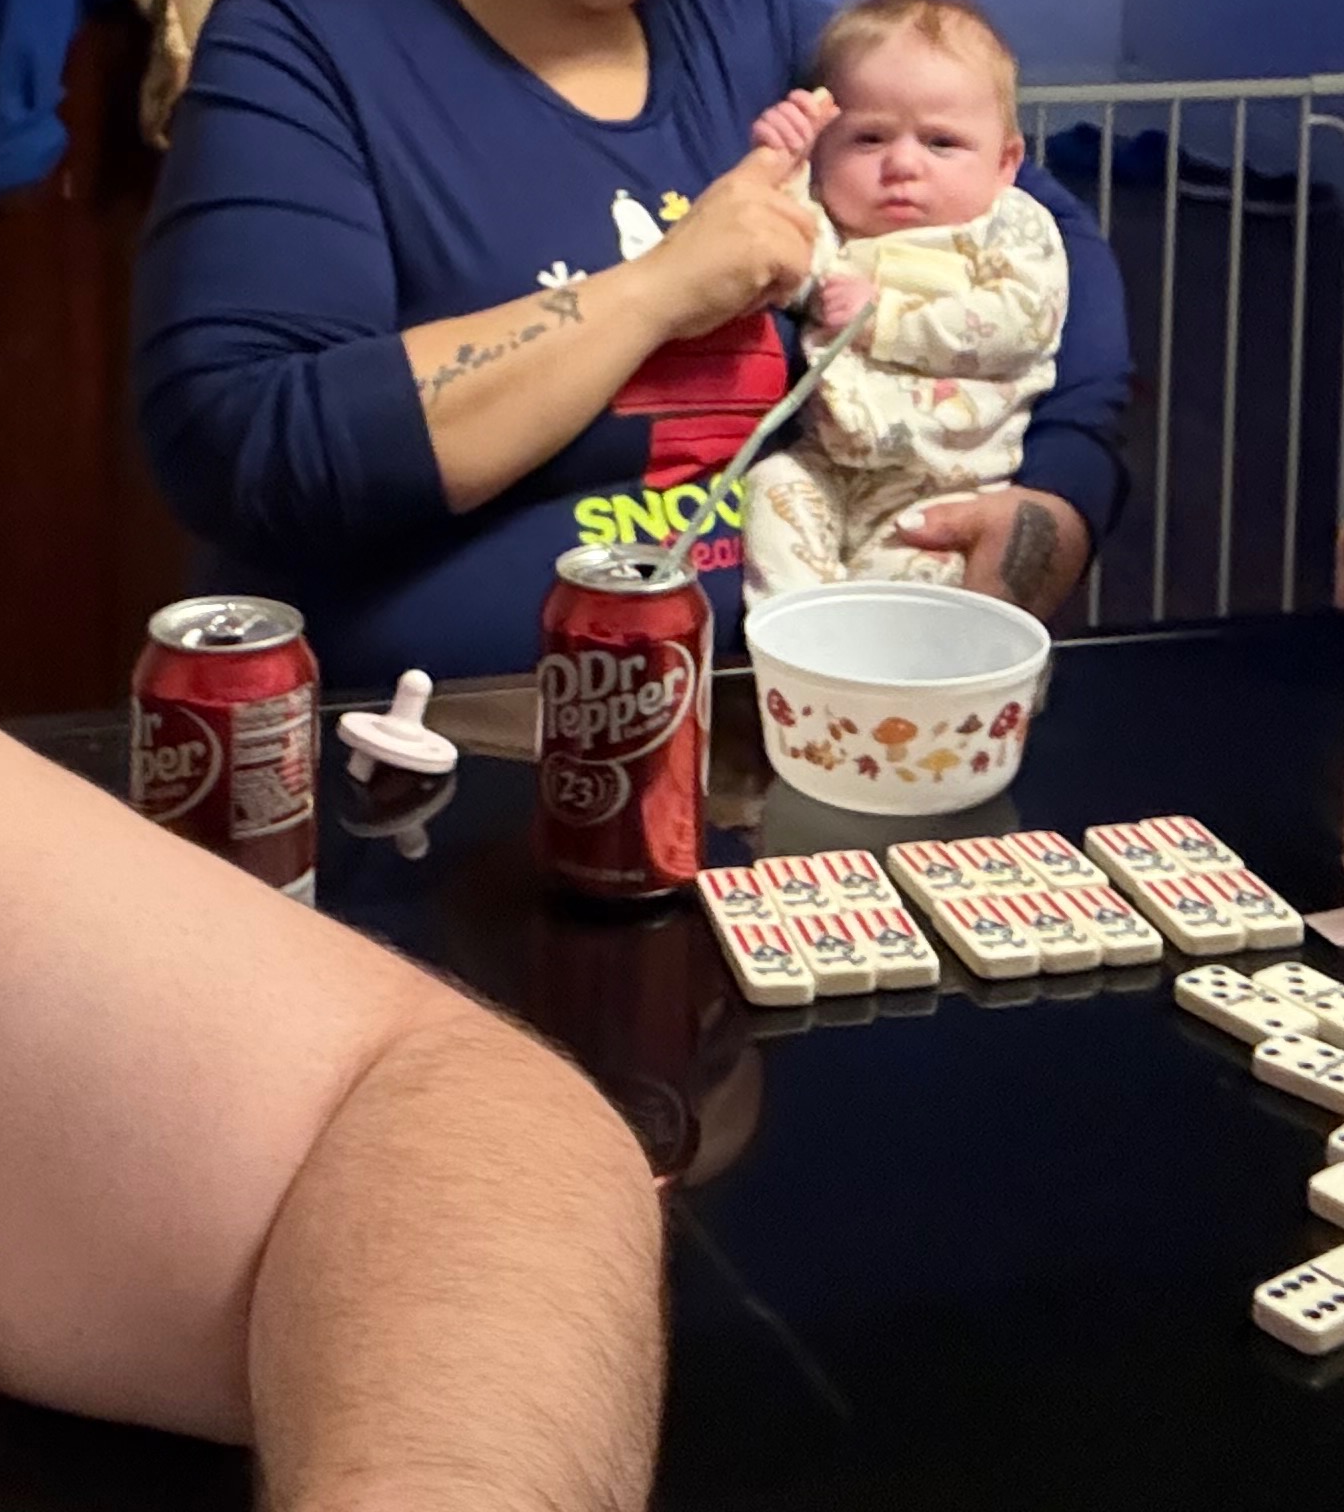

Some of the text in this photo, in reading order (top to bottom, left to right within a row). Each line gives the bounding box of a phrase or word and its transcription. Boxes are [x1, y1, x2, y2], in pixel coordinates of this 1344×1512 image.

[573, 472, 744, 546] SNOO
[536, 652, 685, 750] Pepper
[579, 649, 646, 701] Dr
[559, 771, 595, 809] 23
